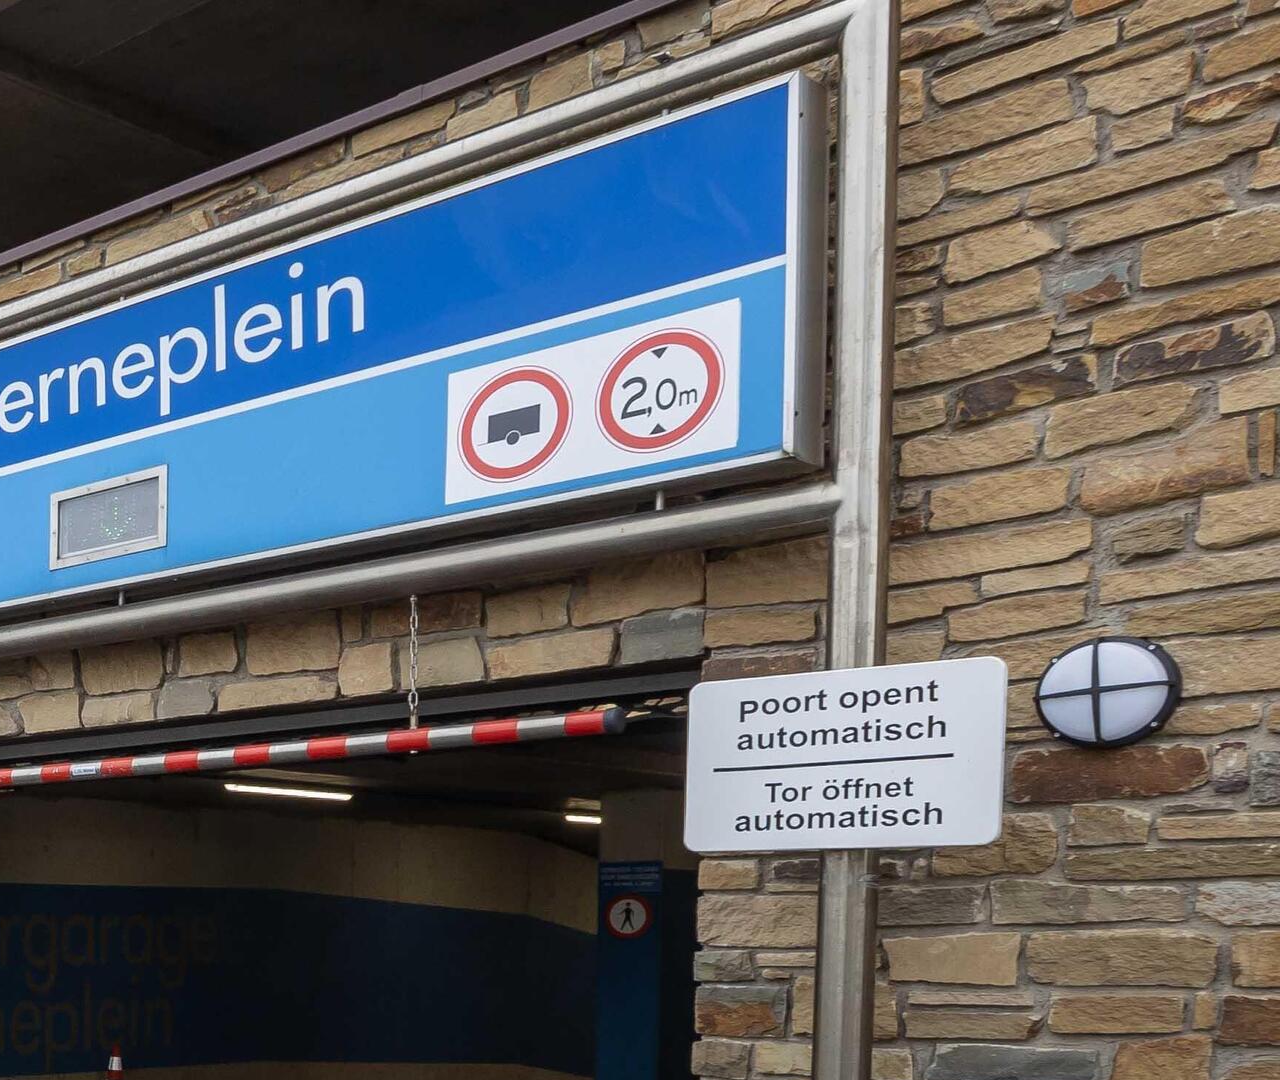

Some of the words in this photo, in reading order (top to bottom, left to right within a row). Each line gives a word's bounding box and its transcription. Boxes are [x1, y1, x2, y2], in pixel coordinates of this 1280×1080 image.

[620, 376, 698, 420] 2,0m
[839, 680, 939, 714] opent
[737, 715, 946, 751] automatisch
[764, 782, 813, 803] Tor
[822, 777, 914, 801] öffnet
[734, 801, 943, 833] automatisch
